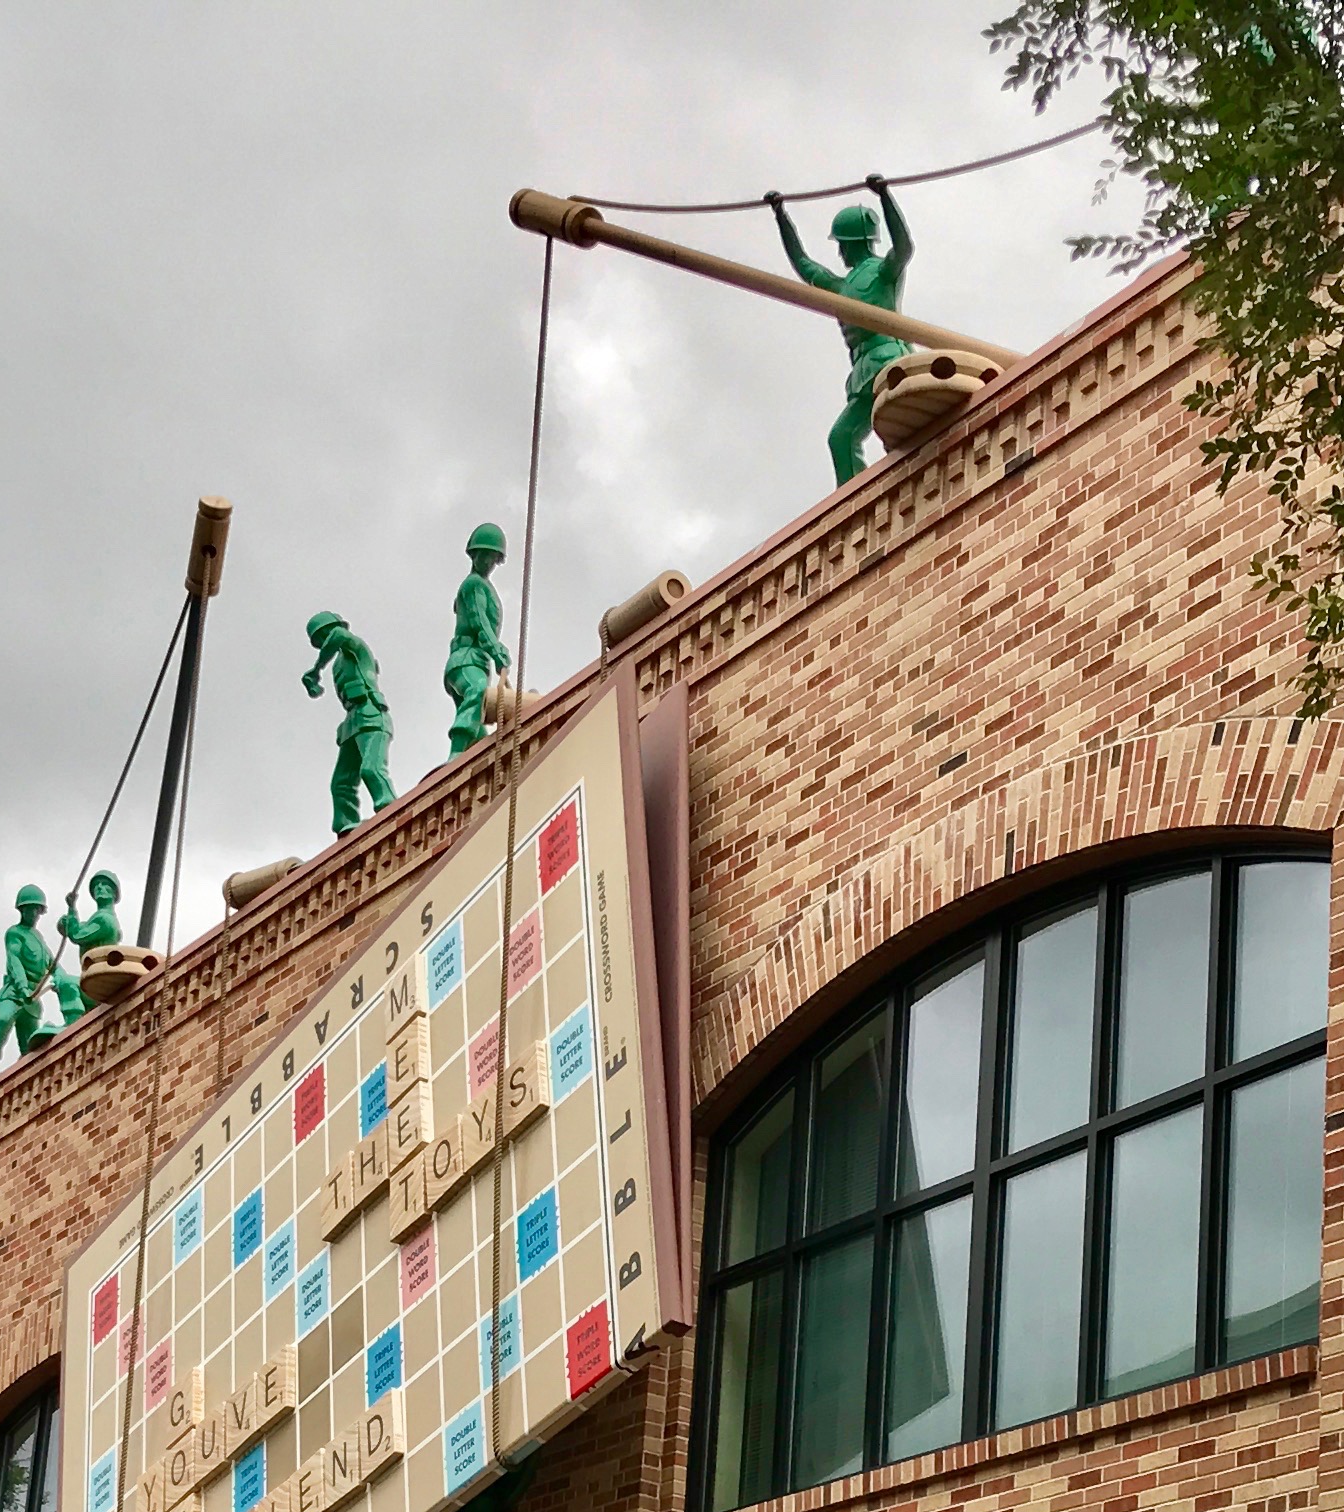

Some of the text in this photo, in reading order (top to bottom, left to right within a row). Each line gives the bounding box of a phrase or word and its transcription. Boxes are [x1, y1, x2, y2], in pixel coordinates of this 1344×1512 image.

[508, 925, 535, 956] DOUBLE
[597, 870, 613, 1003] CROSSWORD GAME
[432, 937, 456, 966] DOUBLE
[511, 943, 533, 967] WORD
[434, 953, 454, 977] LETTER
[513, 956, 534, 982] SCORE
[435, 966, 455, 991] SCORE
[557, 1024, 584, 1055] DOUBLE
[560, 1041, 582, 1067] LETTER
[560, 1056, 583, 1082] SCORE
[398, 1066, 526, 1211] TOYS
[526, 1207, 547, 1231] TRIPLE
[269, 1235, 291, 1260] DOUBLE
[526, 1223, 548, 1248] LETTER
[271, 1251, 288, 1271] LETTER
[406, 1238, 430, 1266] DOUBLE
[527, 1237, 550, 1262] SCORE
[271, 1263, 289, 1285] SCORE
[408, 1256, 428, 1278] WORD
[302, 1268, 323, 1294] DOUBLE
[409, 1269, 429, 1292] SCORE
[303, 1284, 322, 1306] LETTER
[303, 1297, 322, 1319] SCORE
[374, 1341, 393, 1364] TRIPLE
[374, 1356, 394, 1379] LETTER
[374, 1370, 395, 1393] SCORE
[451, 1418, 477, 1447] DOUBLE
[454, 1437, 475, 1460] LETTER
[454, 1452, 476, 1476] SCORE
